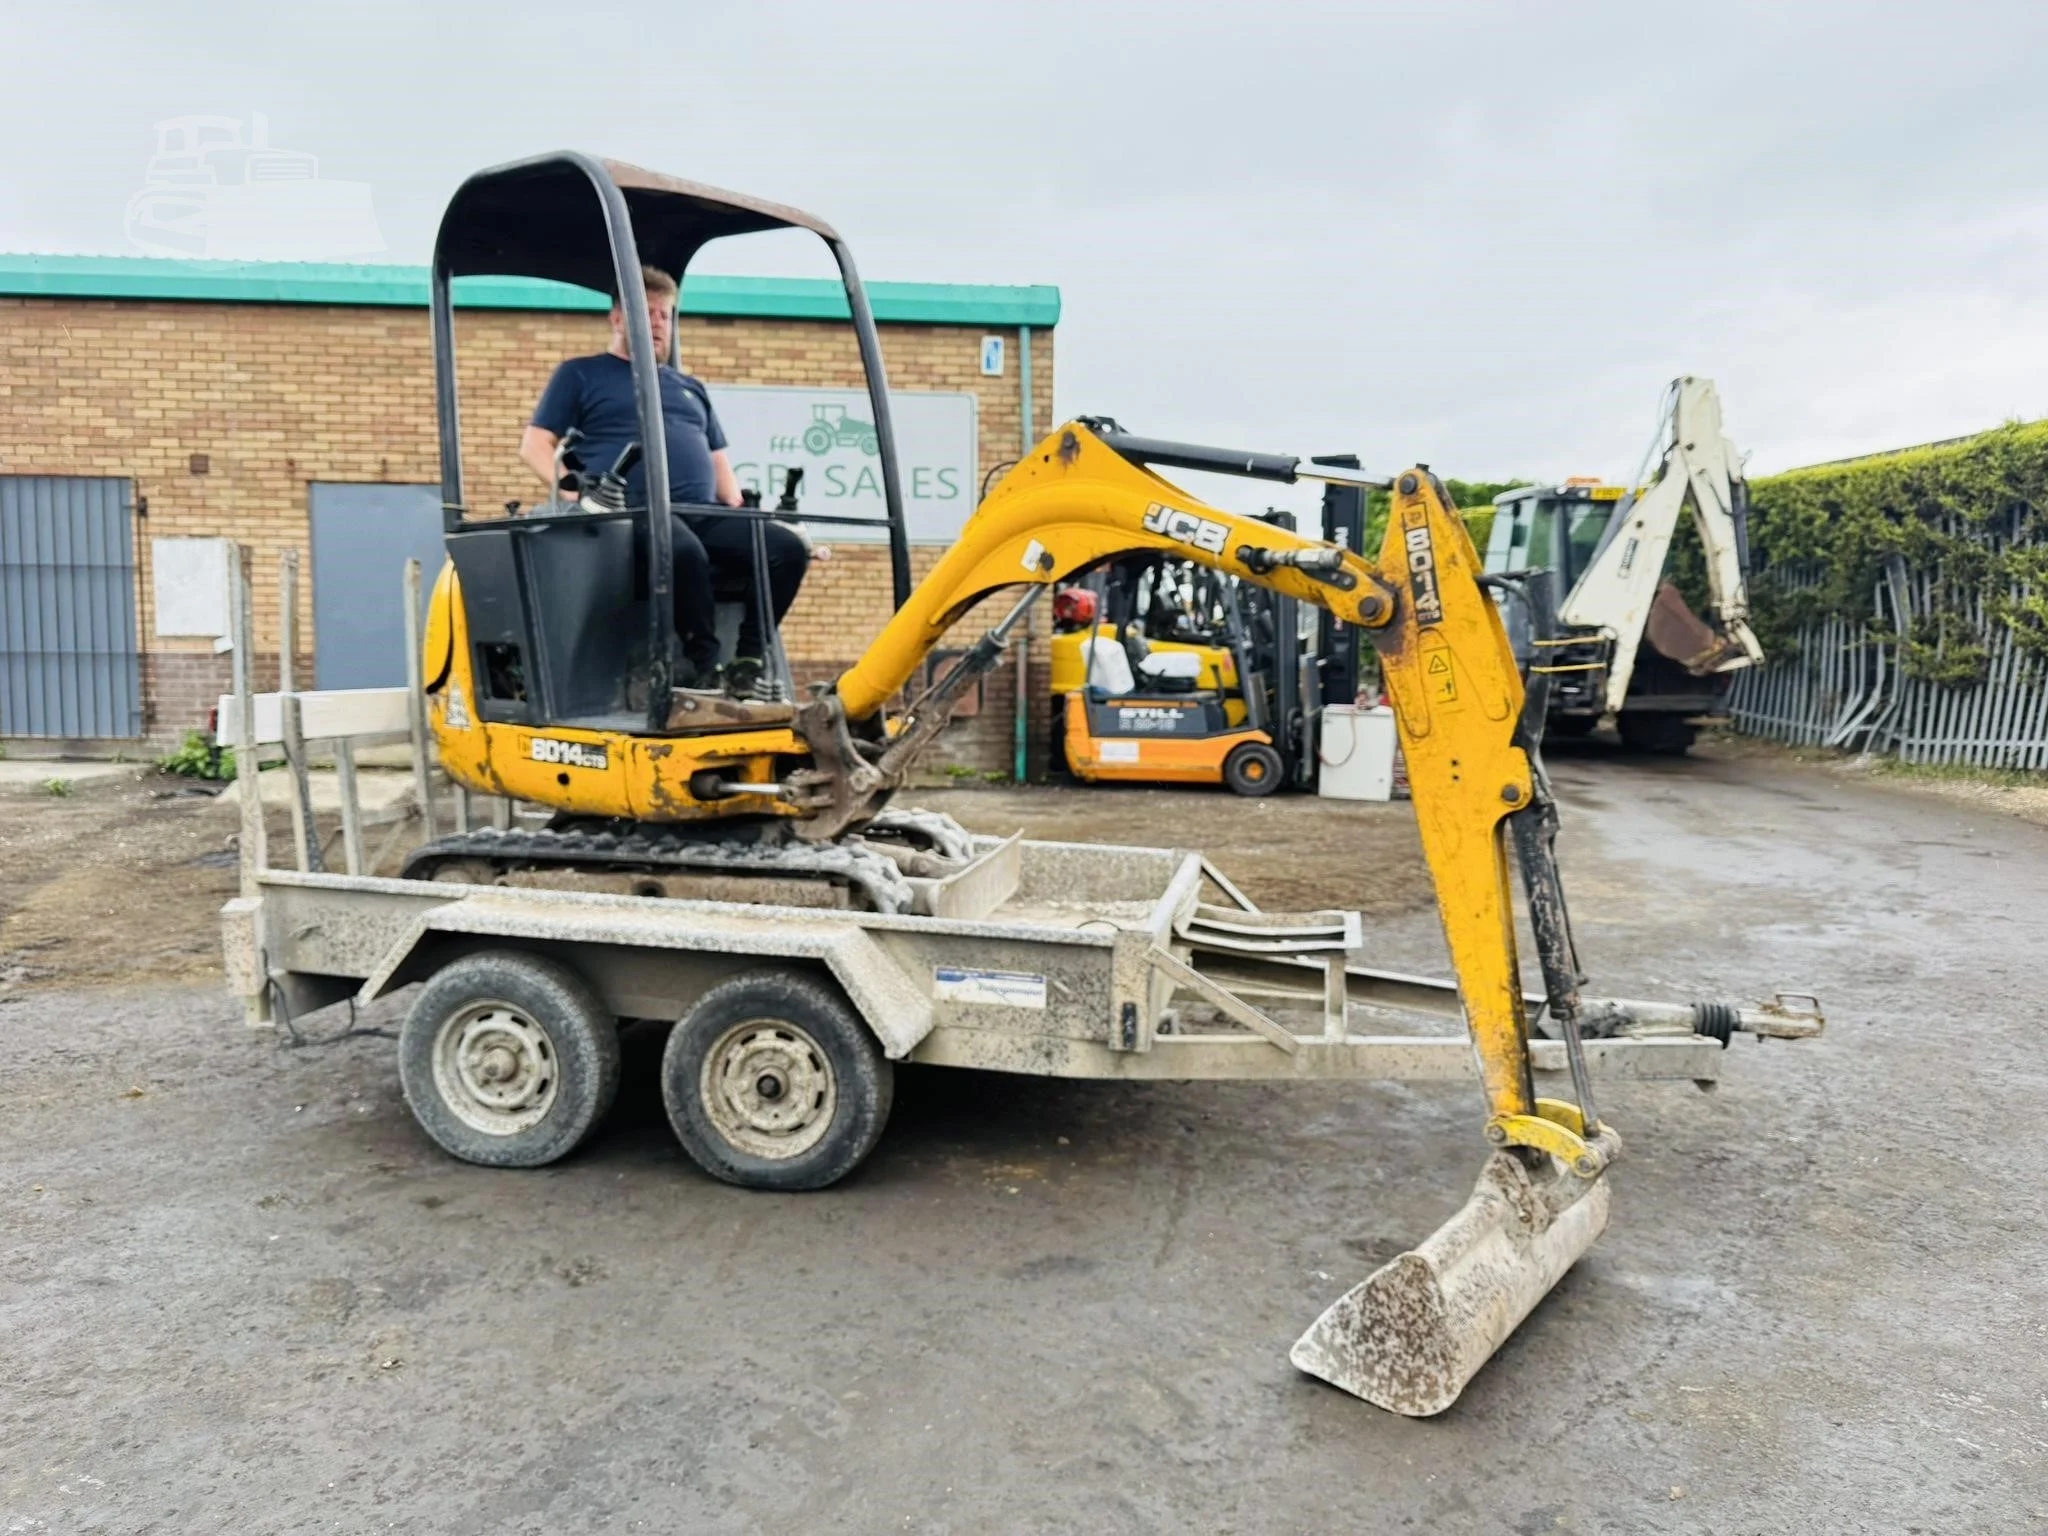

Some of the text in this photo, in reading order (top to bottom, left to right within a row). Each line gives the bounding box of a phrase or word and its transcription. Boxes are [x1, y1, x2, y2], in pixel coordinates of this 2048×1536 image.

[733, 462, 959, 500] GRI SAES
[1143, 504, 1230, 554] JCB
